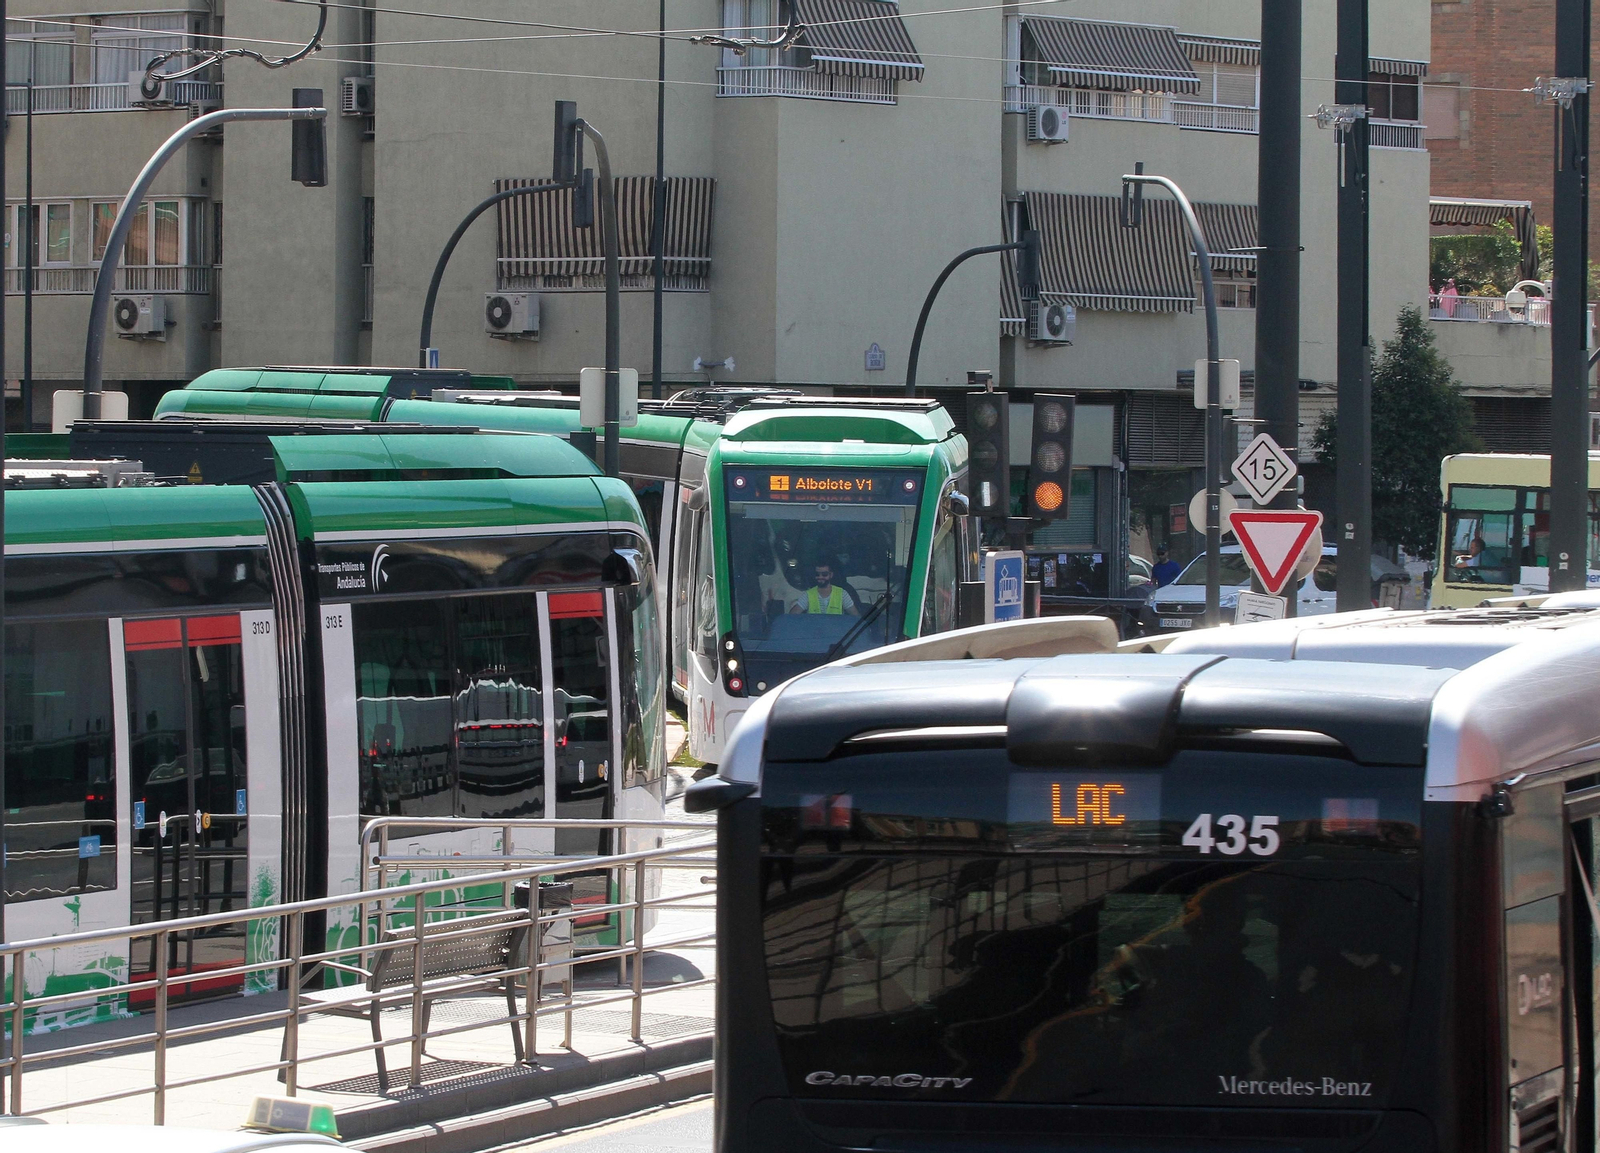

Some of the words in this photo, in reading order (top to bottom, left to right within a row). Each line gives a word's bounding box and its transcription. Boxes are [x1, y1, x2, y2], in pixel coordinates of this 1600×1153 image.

[1249, 458, 1276, 480] 15
[795, 477, 852, 490] Albolote
[855, 478, 873, 490] V1
[317, 563, 341, 574] Transportes
[342, 561, 359, 571] Públicos
[359, 562, 365, 571] de
[337, 575, 366, 589] Andalucía
[252, 622, 264, 634] 313
[326, 616, 338, 629] 313
[1050, 783, 1126, 826] LAC
[1181, 813, 1280, 856] 435
[1218, 1075, 1372, 1096] Mercedes-Benz
